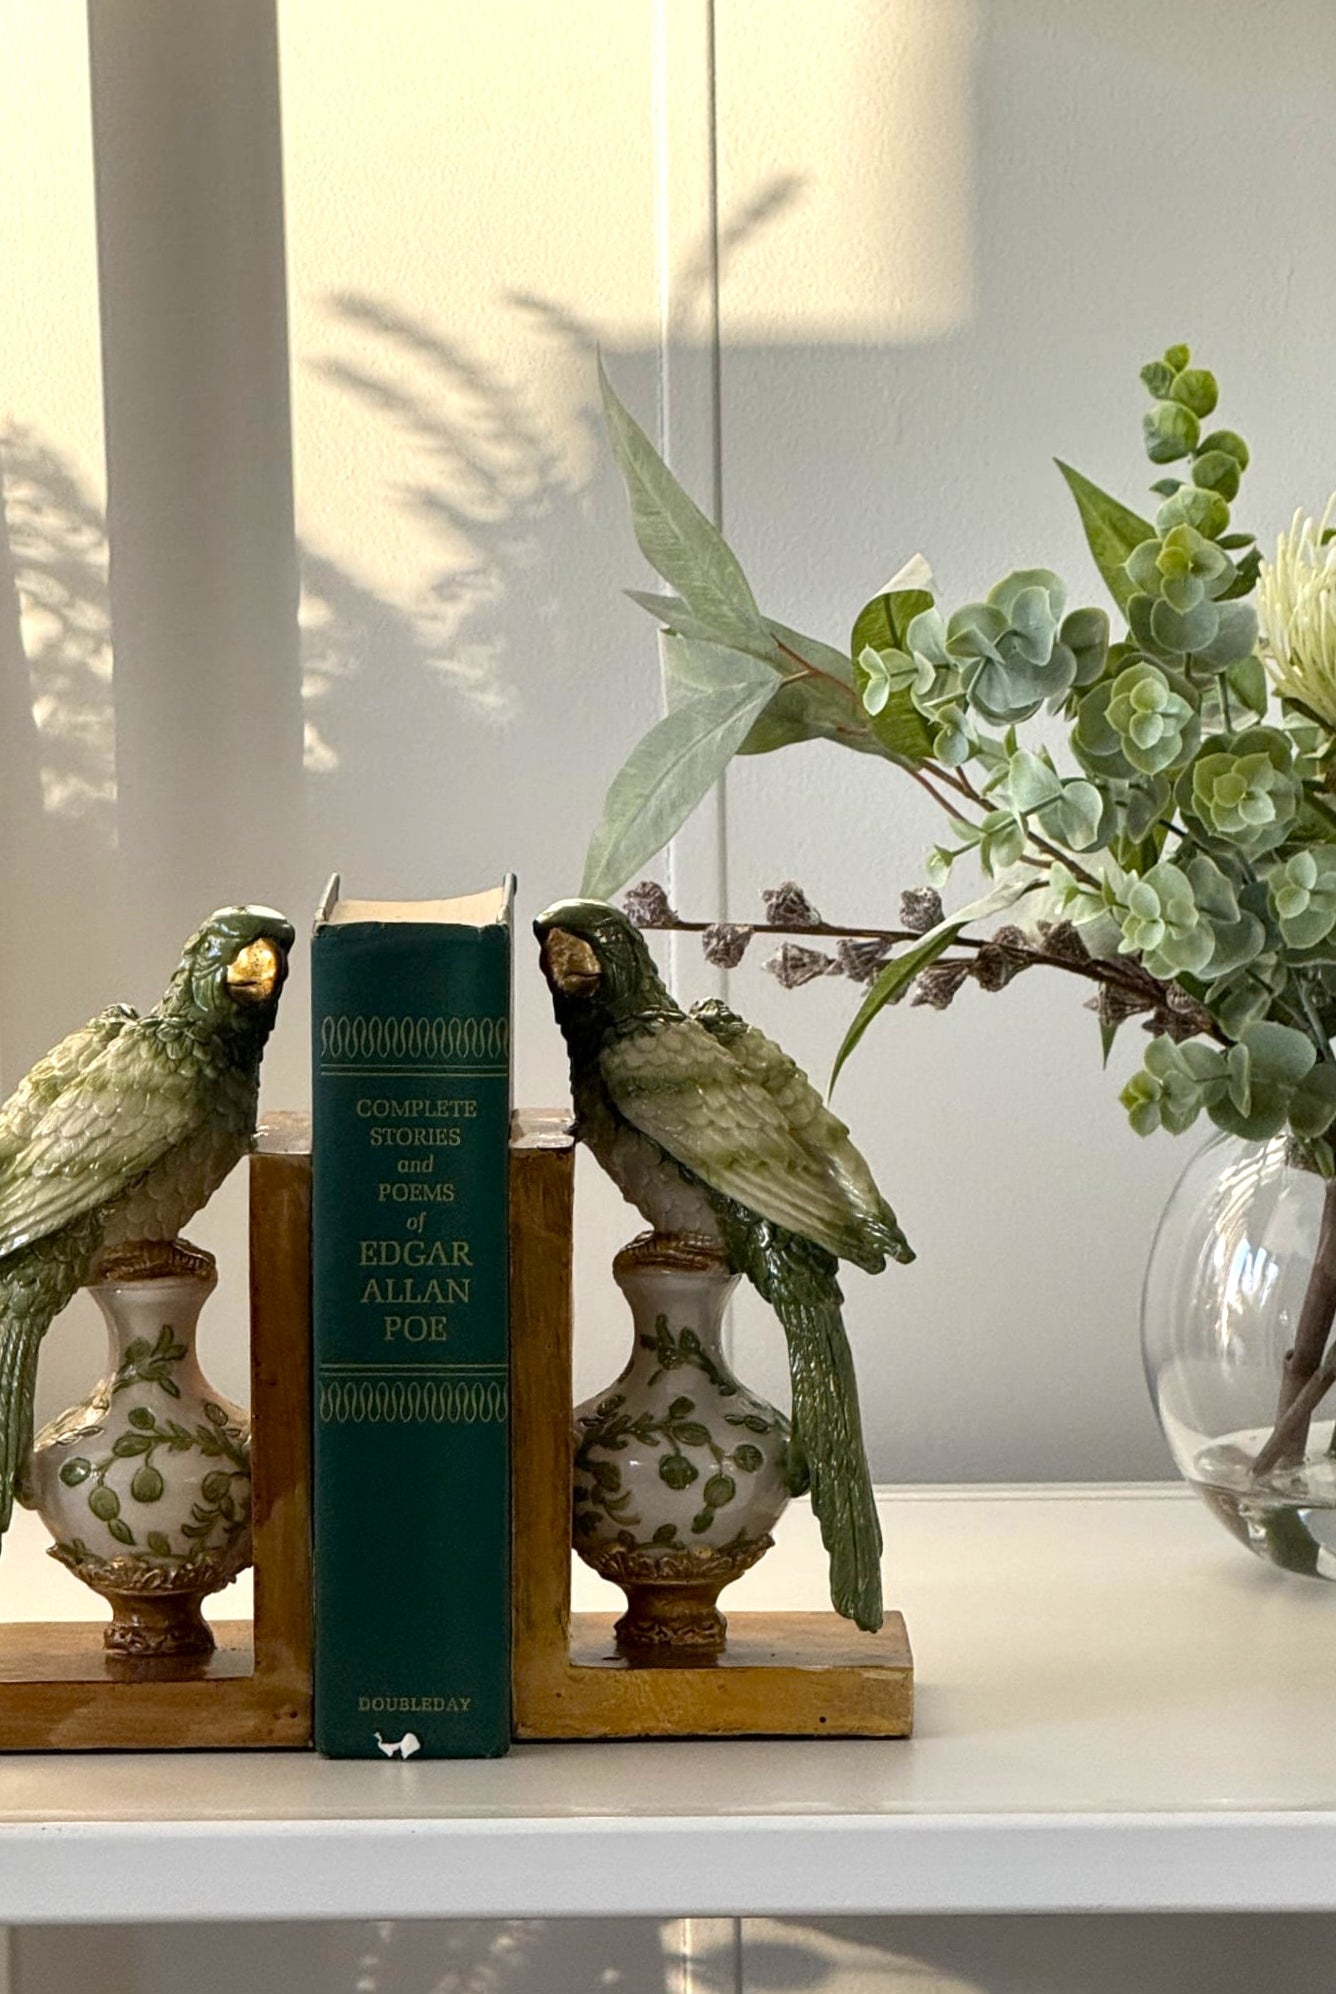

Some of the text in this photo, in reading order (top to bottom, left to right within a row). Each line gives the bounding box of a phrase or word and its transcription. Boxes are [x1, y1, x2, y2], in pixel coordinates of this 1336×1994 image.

[357, 1099, 477, 1118] COMPLETE
[370, 1127, 461, 1146] STORIES
[397, 1154, 434, 1173] and
[378, 1183, 455, 1202] POEMS
[406, 1211, 426, 1233] of
[359, 1240, 473, 1266] EDGAR
[361, 1278, 470, 1304] ALLAN
[384, 1316, 447, 1341] POE
[358, 1697, 472, 1712] DOUBLEDAY
